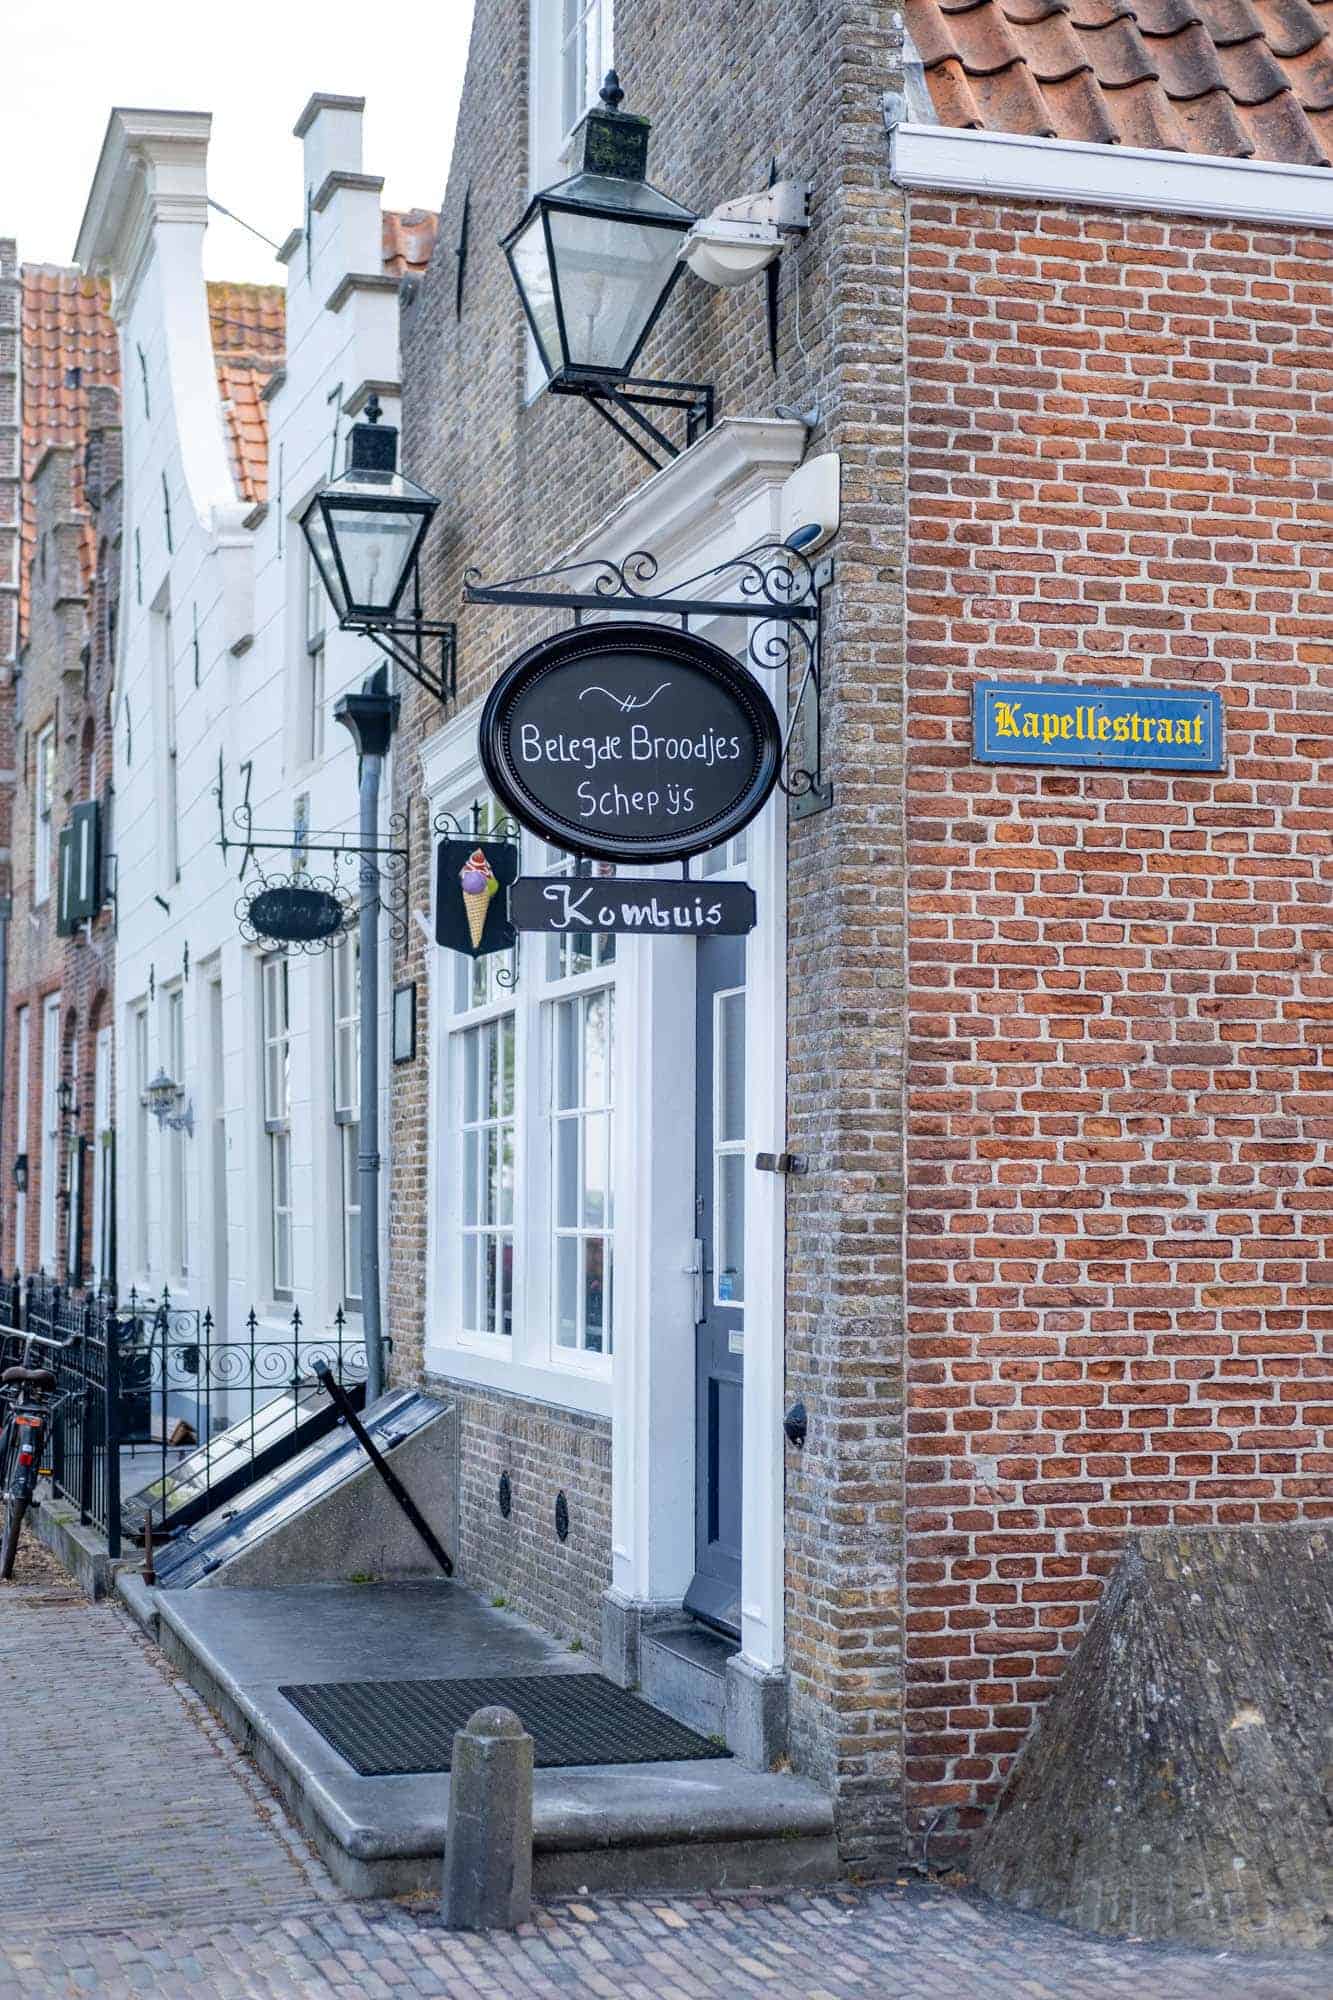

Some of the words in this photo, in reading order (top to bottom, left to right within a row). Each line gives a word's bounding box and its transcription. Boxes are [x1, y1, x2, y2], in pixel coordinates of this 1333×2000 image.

[994, 701, 1205, 745] Kapellestraat
[521, 723, 623, 769] Belegde
[631, 724, 740, 766] Broodjes
[577, 780, 659, 816] Schep
[543, 884, 722, 928] Kombuis
